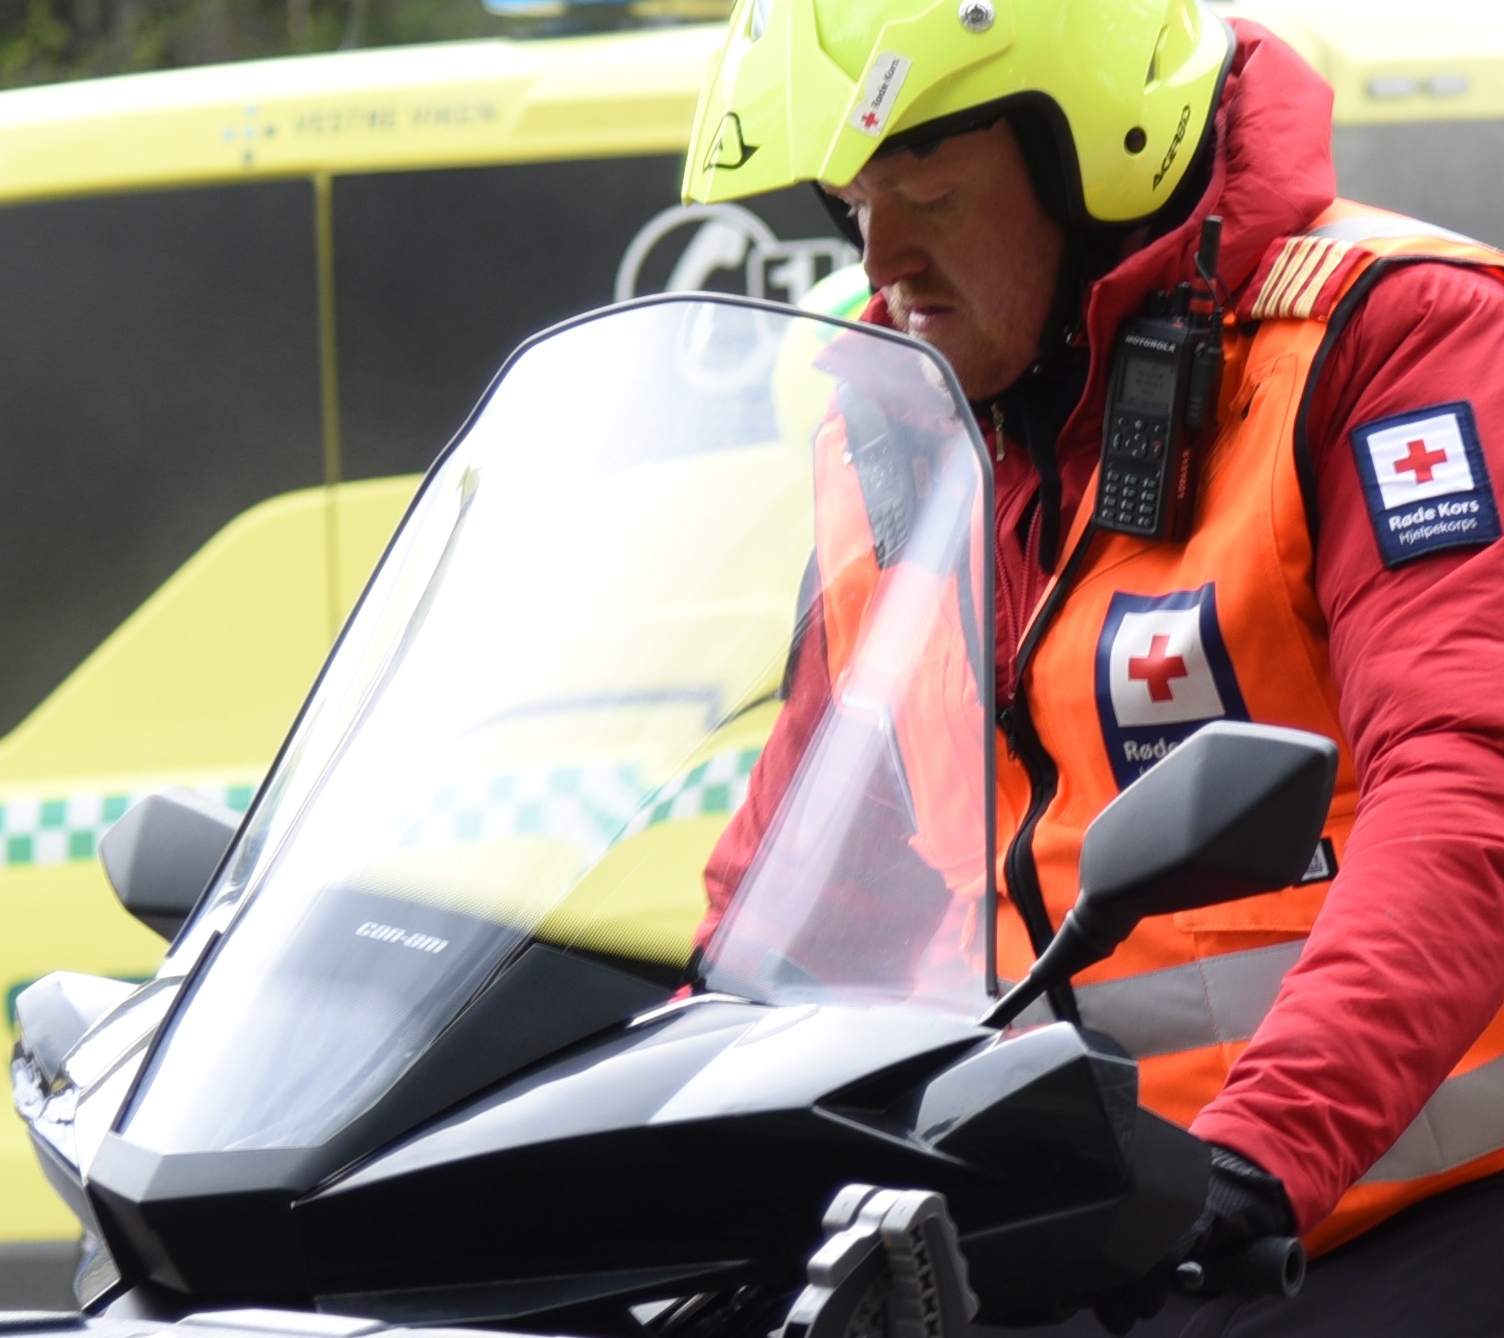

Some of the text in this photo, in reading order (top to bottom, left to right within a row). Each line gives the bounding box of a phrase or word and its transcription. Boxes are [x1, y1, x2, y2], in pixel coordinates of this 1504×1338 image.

[1125, 335, 1176, 353] MOTOROLA
[1388, 499, 1480, 532] Røde Kors
[1398, 517, 1478, 545] Hjelpekorps
